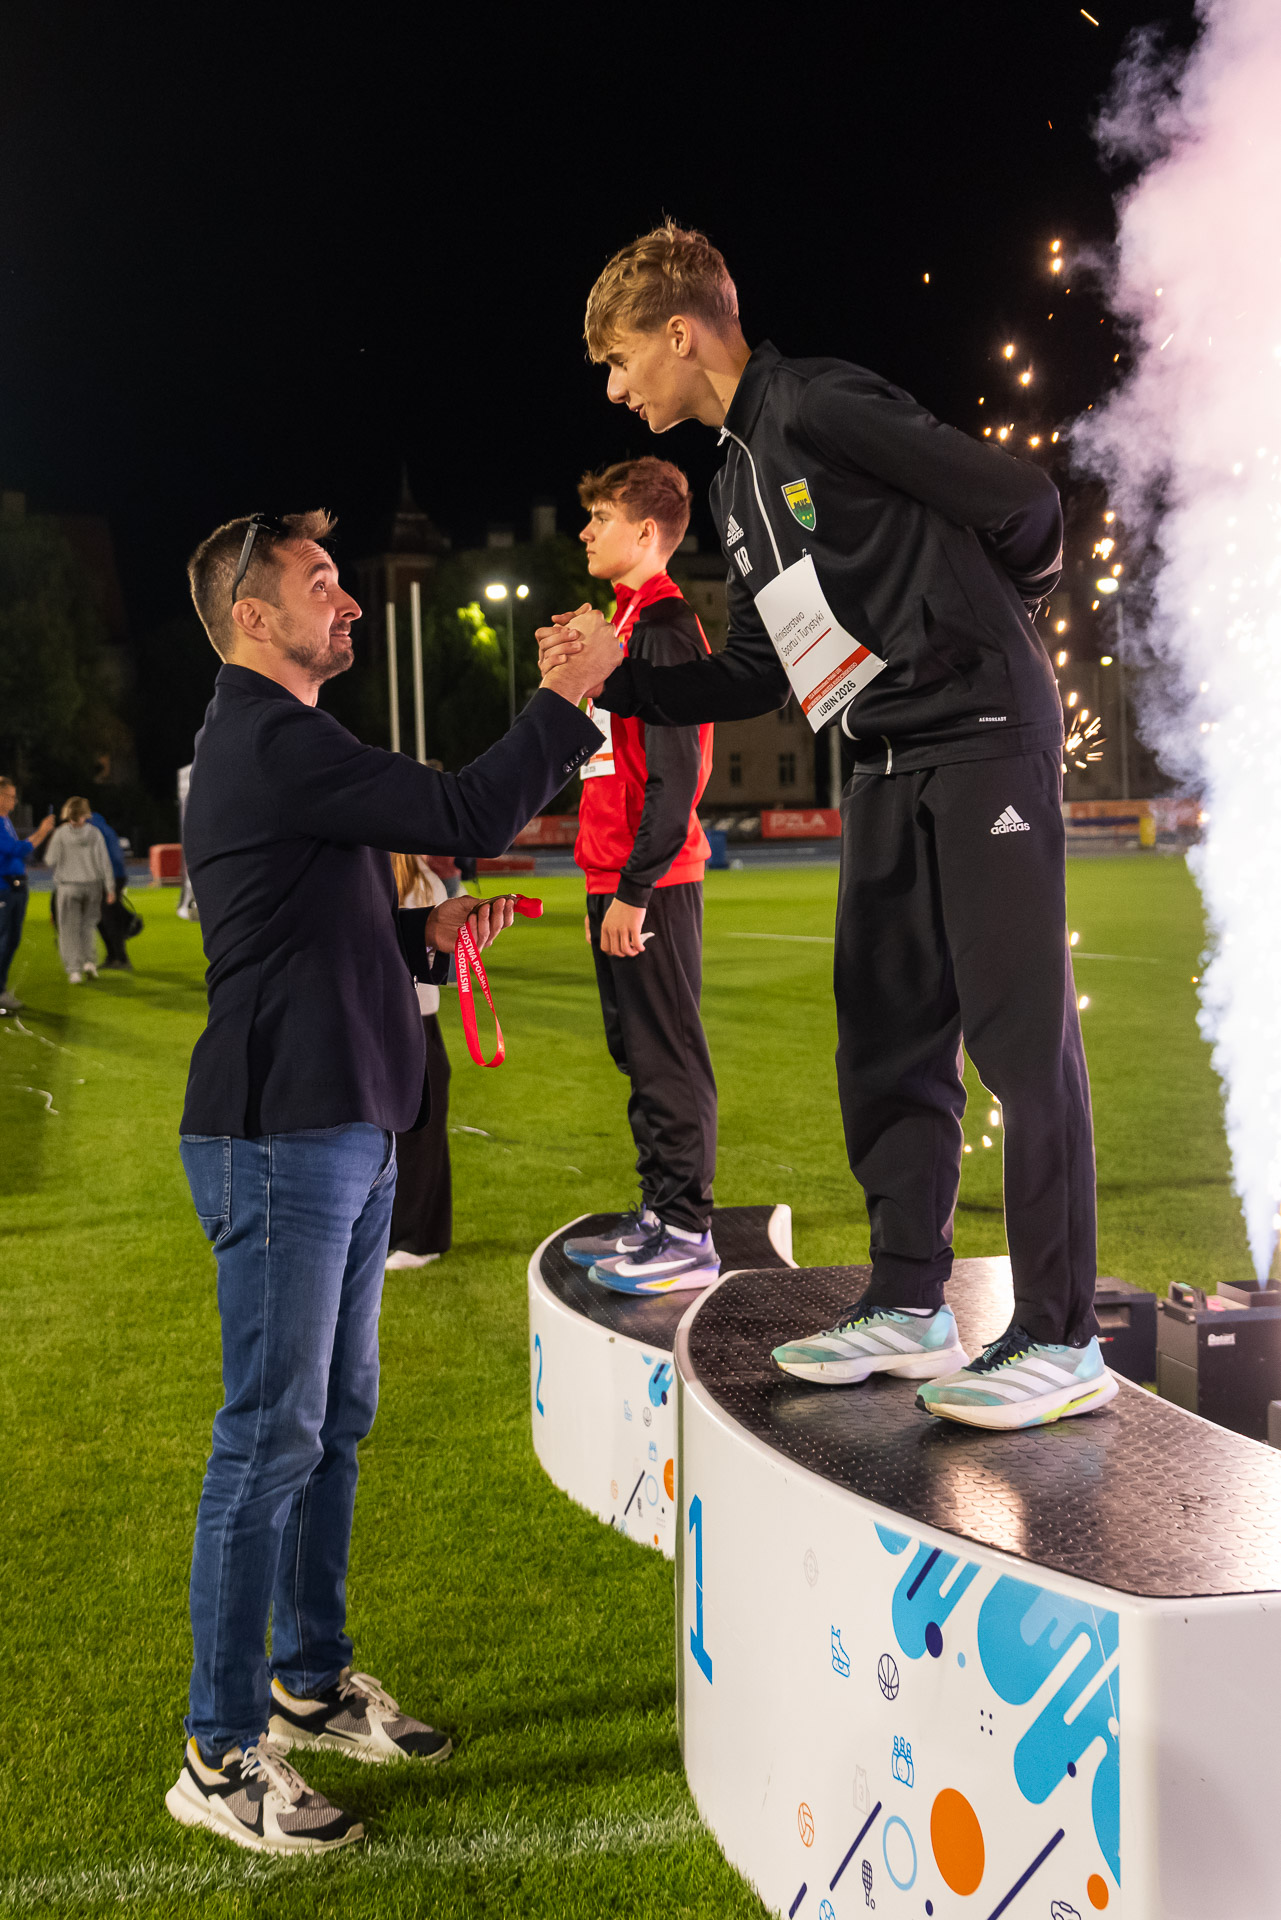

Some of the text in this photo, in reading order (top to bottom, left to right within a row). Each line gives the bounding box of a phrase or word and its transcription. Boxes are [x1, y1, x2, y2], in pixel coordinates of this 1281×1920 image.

[726, 527, 745, 547] adidas
[734, 546, 753, 577] KR
[774, 611, 805, 642] Ministerstwo
[781, 640, 799, 657] Sportu
[797, 610, 825, 634] Turystyki
[817, 695, 839, 717] LUBIN
[835, 680, 857, 700] 2026
[990, 822, 1031, 835] adidas
[460, 923, 476, 961] RZOSTWA
[472, 961, 487, 989] POLSKI
[534, 1333, 545, 1418] 2
[689, 1494, 713, 1686] 1
